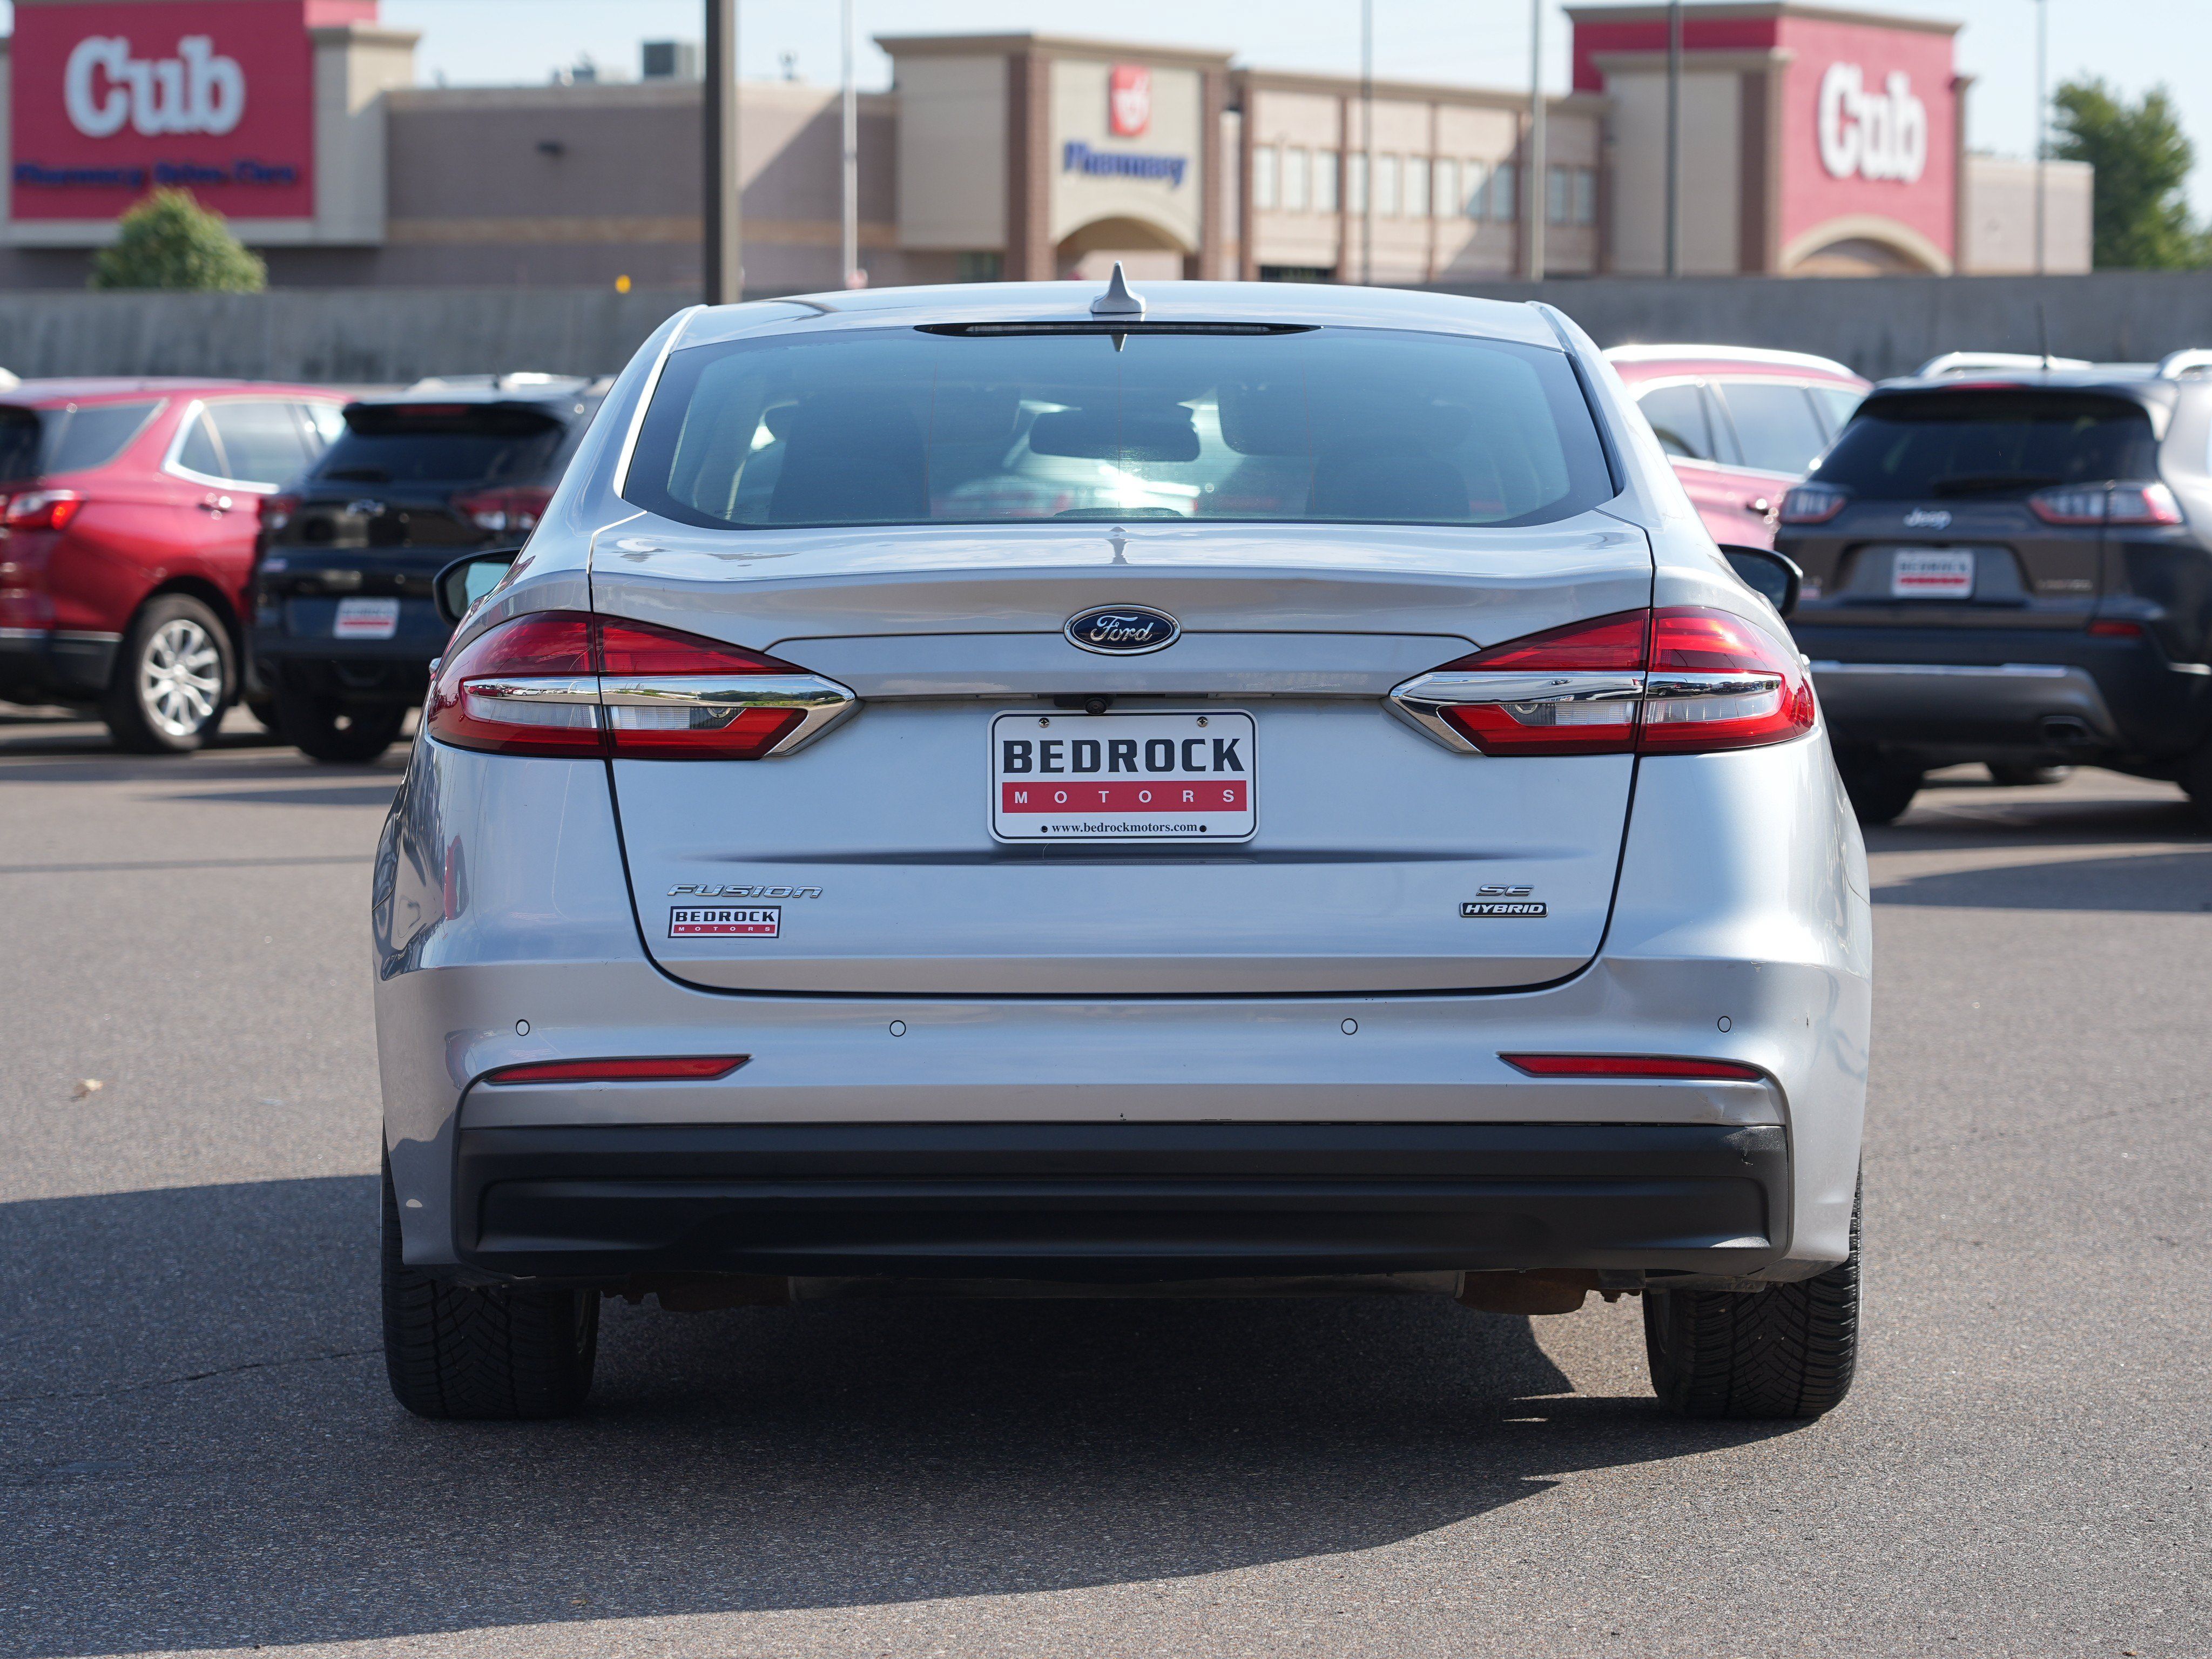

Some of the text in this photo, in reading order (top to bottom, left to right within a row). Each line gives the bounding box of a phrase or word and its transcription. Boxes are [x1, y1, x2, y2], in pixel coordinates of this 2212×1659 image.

[64, 35, 246, 138] Cub
[1818, 61, 1927, 183] Cub
[1902, 505, 1953, 530] Jeep
[1090, 615, 1154, 642] Ford
[1003, 738, 1245, 774] BEDROCK
[1014, 789, 1235, 804] MOTORS
[1051, 821, 1198, 833] www.bedrockmotors.com
[1476, 884, 1534, 896] SE
[675, 911, 775, 922] BEDROCK
[1465, 904, 1544, 913] HYBRID
